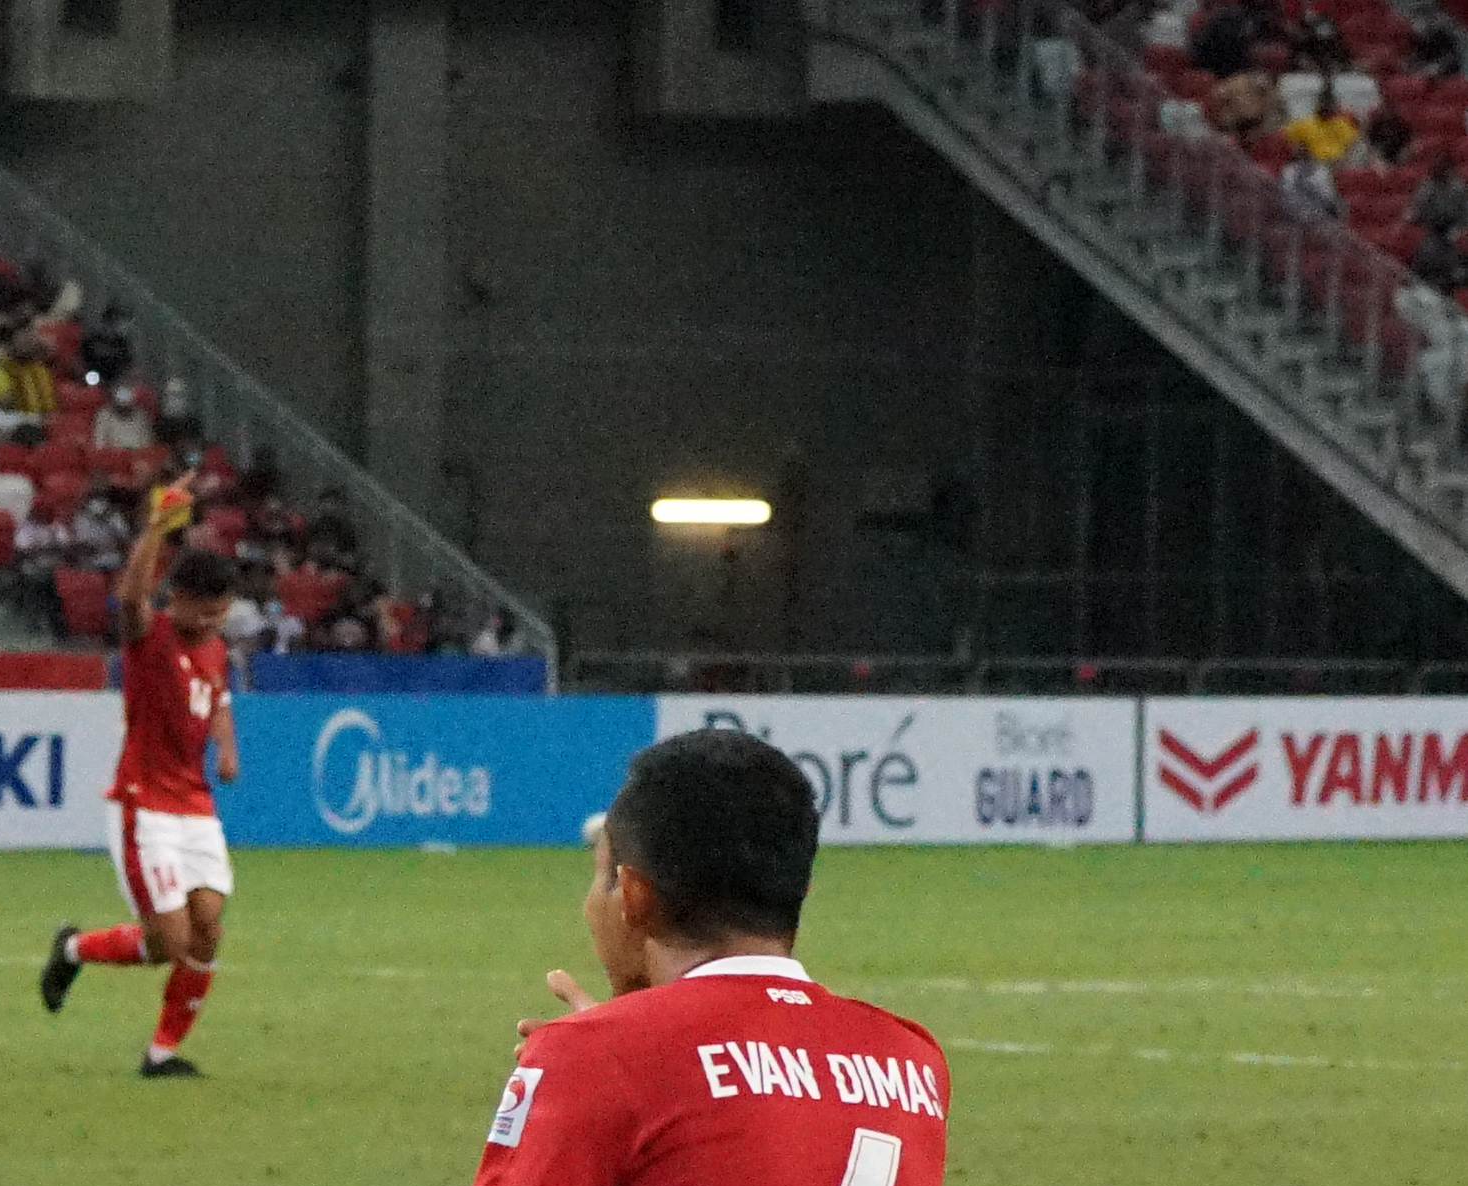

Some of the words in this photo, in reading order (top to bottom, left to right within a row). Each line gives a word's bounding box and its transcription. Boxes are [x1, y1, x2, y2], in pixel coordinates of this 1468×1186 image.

[313, 708, 492, 834] Midea
[973, 767, 1095, 827] GUARD
[765, 987, 813, 1006] PSSI
[697, 1040, 821, 1100] EVAN
[826, 1053, 945, 1121] DIMAS
